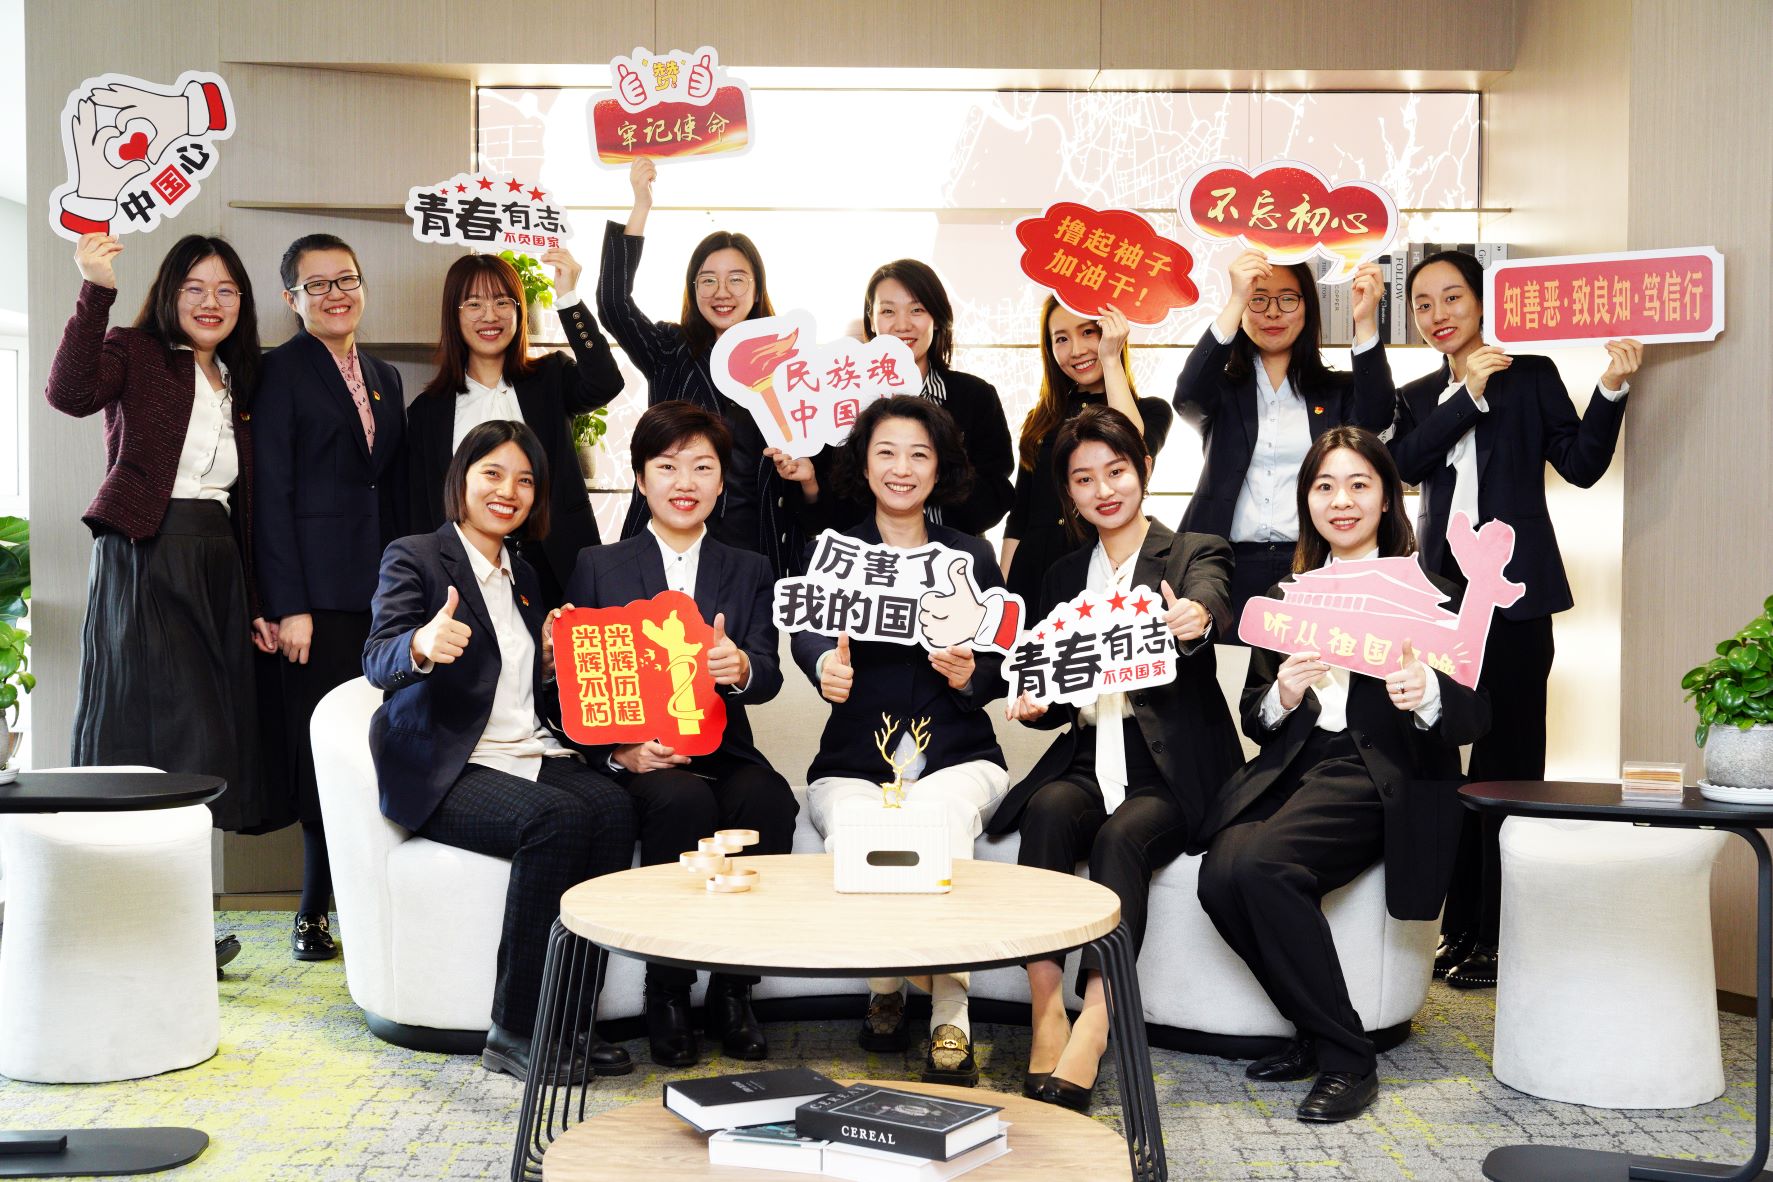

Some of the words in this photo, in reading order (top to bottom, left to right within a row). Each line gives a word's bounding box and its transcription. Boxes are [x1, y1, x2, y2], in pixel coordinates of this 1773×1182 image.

[617, 112, 730, 152] 牢记使命
[120, 143, 210, 223] 中国心
[414, 193, 567, 242] 青春有志
[1207, 187, 1369, 236] 不忘初心
[504, 232, 560, 248] 不负国家
[1054, 216, 1172, 277] 撸起袖子
[1395, 257, 1404, 302] FOLLOW
[786, 352, 905, 393] 民族魂
[814, 535, 943, 589] 厉害了
[779, 582, 919, 639] 我的国
[572, 625, 612, 726] 光辉不朽
[605, 624, 645, 724] 光辉历程
[1009, 617, 1176, 699] 青春有志
[1103, 660, 1167, 685] 不负国家
[841, 1125, 896, 1146] CEREAL
